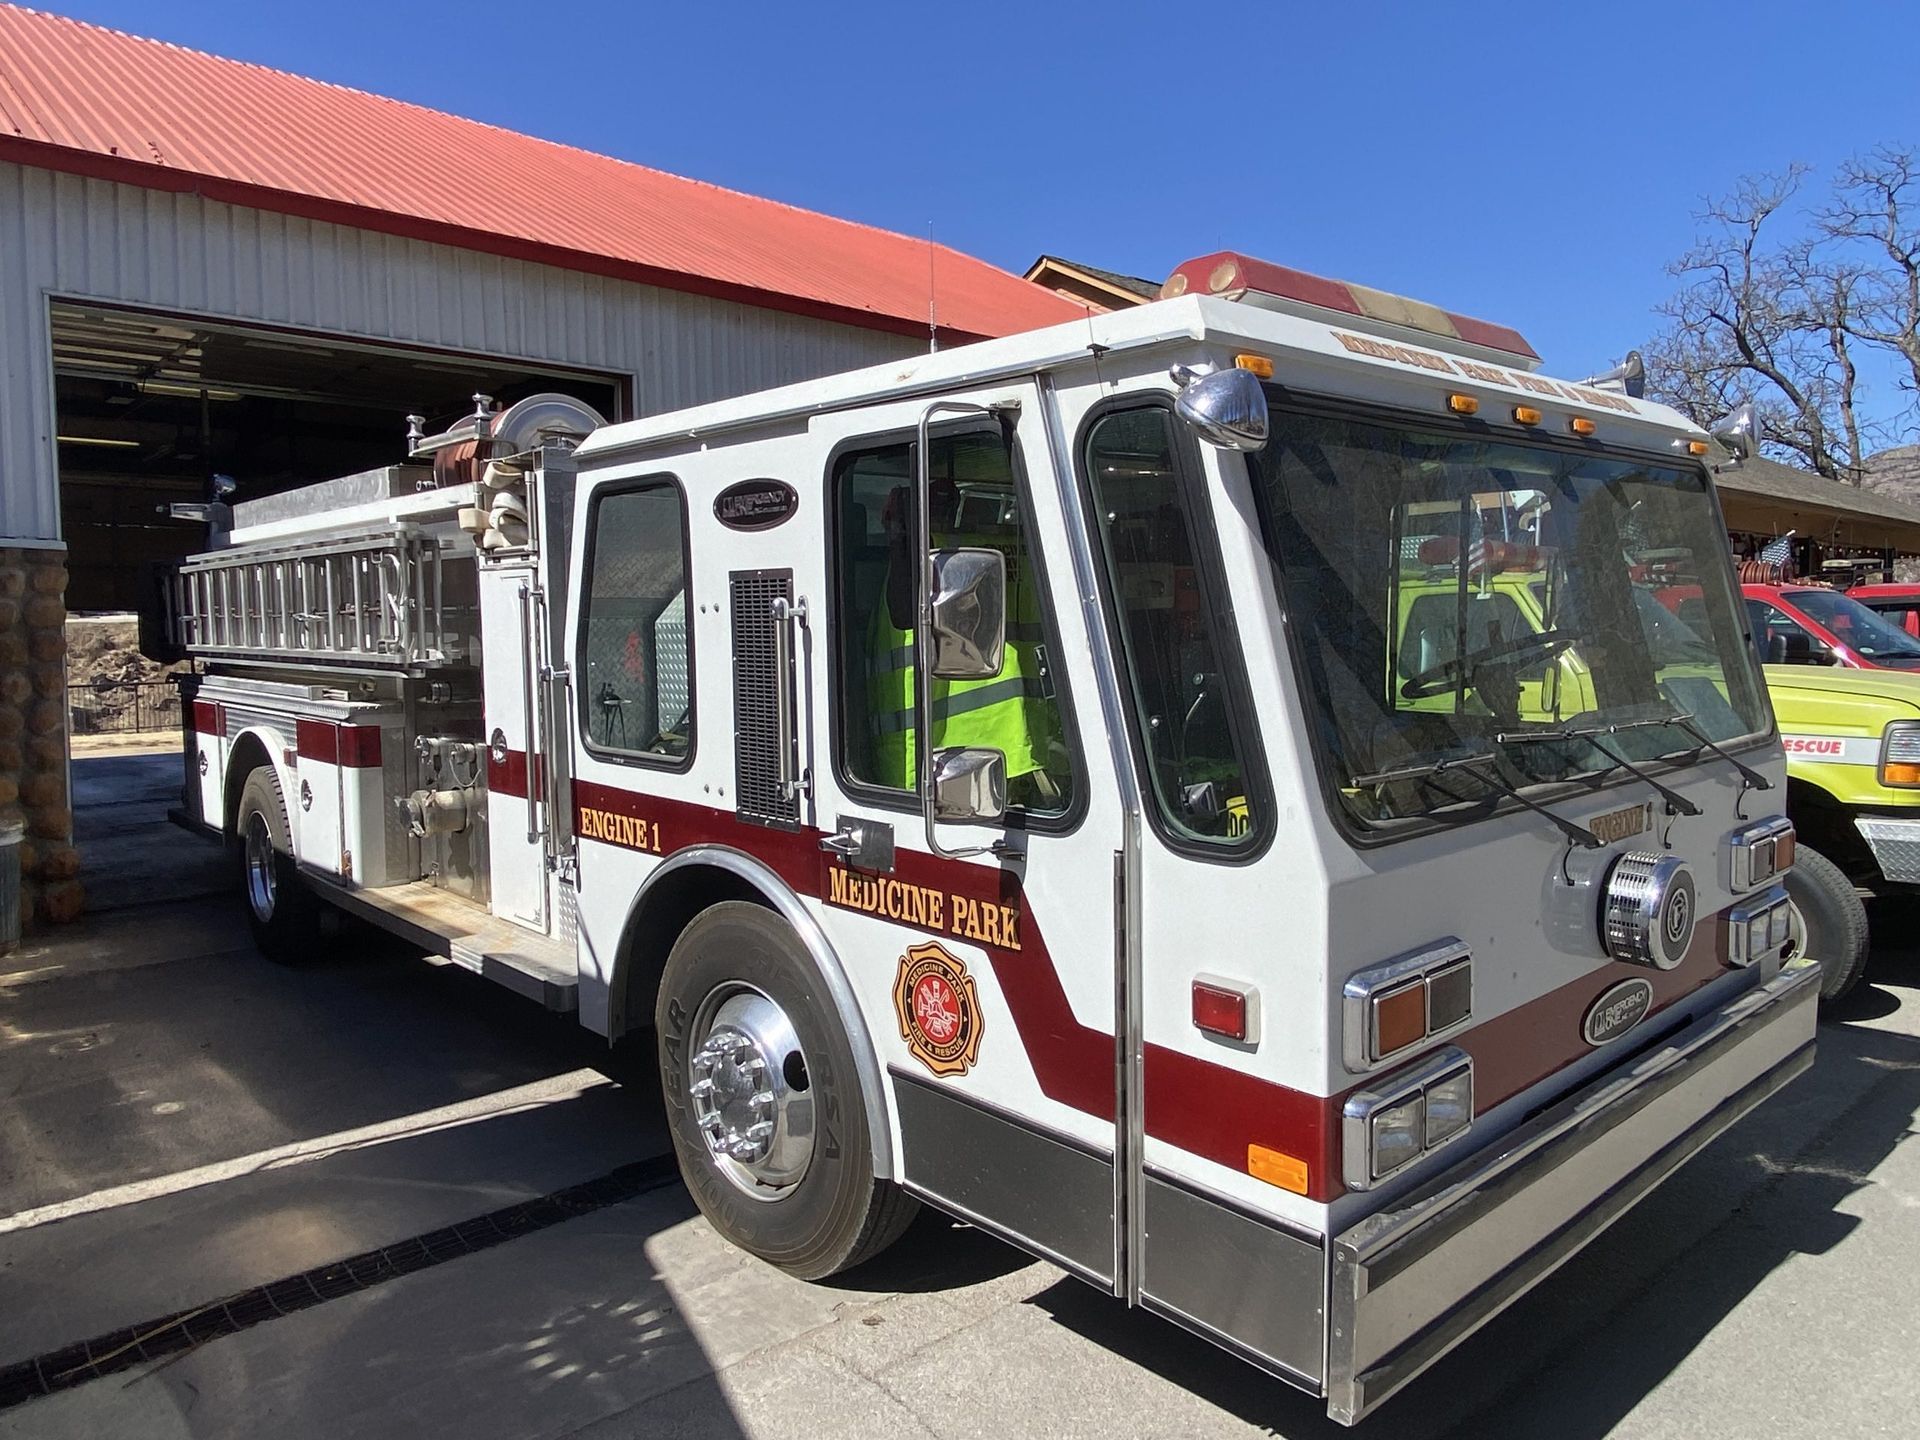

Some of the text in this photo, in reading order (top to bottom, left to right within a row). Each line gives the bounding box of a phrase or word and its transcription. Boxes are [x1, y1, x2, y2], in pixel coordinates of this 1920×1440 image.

[1782, 739, 1841, 754] ESCUE
[581, 807, 661, 852] ENGINE 1
[829, 867, 1021, 950] MEDICINE PARK
[909, 963, 965, 1002] MEDICINE PARK
[911, 1020, 926, 1046] FIRE
[935, 1036, 964, 1056] RESCUE
